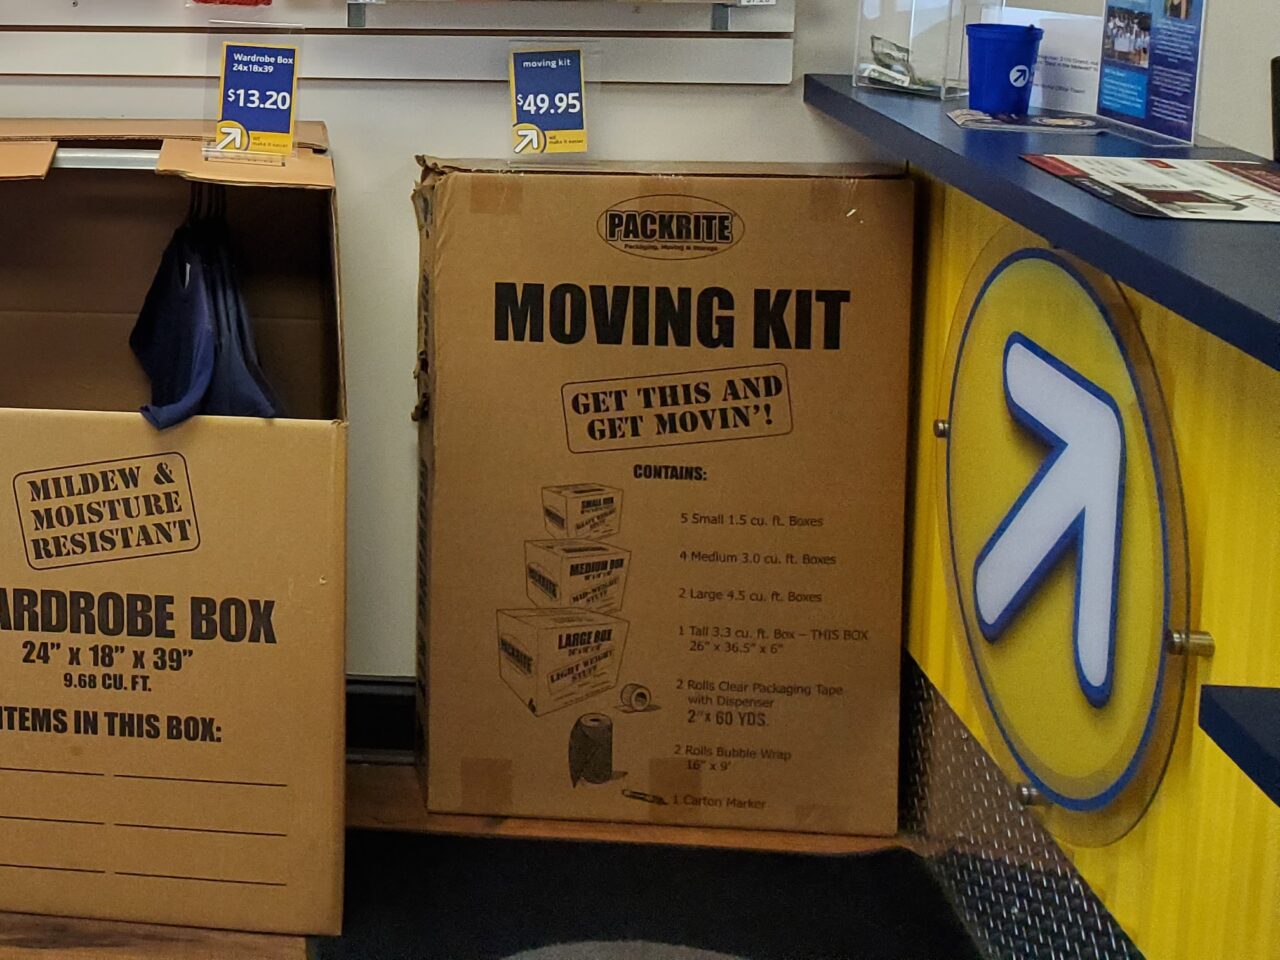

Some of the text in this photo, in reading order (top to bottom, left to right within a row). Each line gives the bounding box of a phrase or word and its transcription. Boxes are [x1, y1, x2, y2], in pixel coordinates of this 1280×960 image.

[232, 63, 274, 73] 24x18x39
[233, 53, 294, 65] Wardrobe Box
[523, 58, 571, 69] moving kit
[227, 88, 291, 110] $13.20
[516, 92, 581, 115] $49.95
[607, 211, 734, 243] PACKRITE
[494, 281, 851, 351] MOVING KIT
[571, 375, 783, 415] GET THIS AND
[586, 403, 773, 441] GET MOVIN'!
[27, 461, 175, 502] MILDEW &
[633, 464, 707, 481] CONTAINS:
[31, 490, 183, 531] MOISTURE
[680, 513, 688, 524] 5
[691, 513, 724, 525] Small
[728, 514, 747, 526] 1.5
[750, 517, 767, 526] cu.
[789, 516, 824, 527] Boxes
[31, 518, 192, 560] RESISTANT
[679, 588, 822, 603] 2 Large 4.5 cu. ft. Boxes
[190, 596, 277, 644] BOX
[63, 672, 151, 692] 9.68 CU. FT.
[676, 679, 844, 697] 2 Rolls Clear Packaging Tape
[688, 695, 774, 708] with Dispenser
[74, 710, 98, 735] IN
[104, 711, 160, 740] THIS
[167, 715, 222, 743] BOX:
